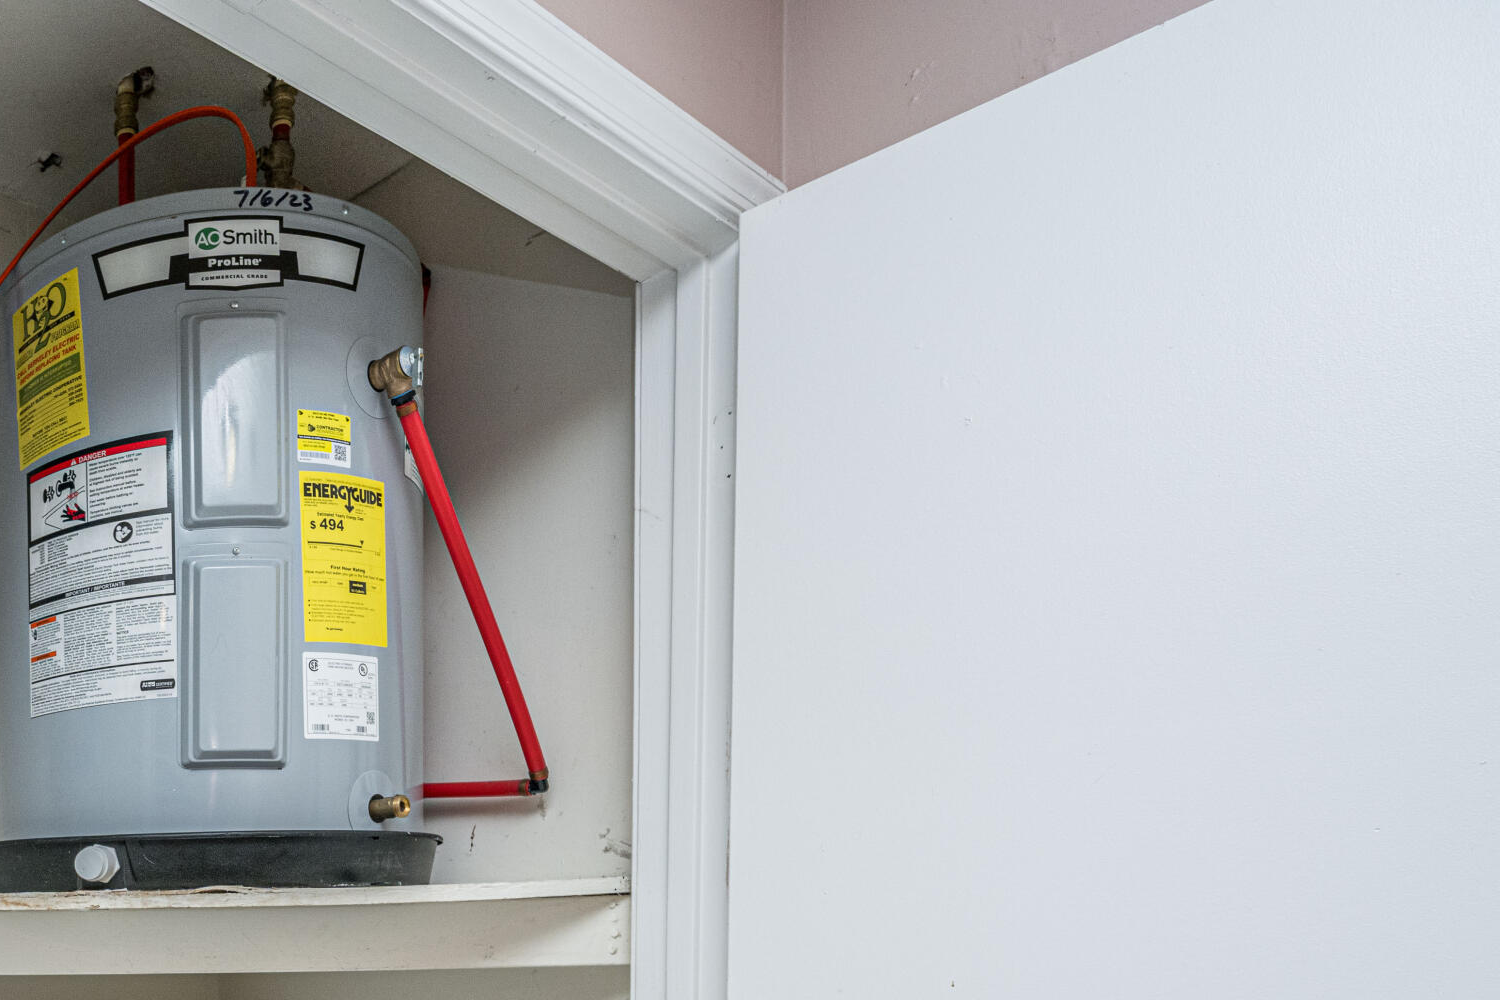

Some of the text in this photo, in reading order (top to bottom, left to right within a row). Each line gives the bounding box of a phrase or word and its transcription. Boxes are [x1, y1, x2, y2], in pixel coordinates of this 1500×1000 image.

[233, 189, 313, 211] 7/6/23
[195, 229, 220, 247] AO
[207, 257, 260, 268] ProLine
[201, 274, 244, 282] COMMERCIAL
[52, 333, 80, 352] ELECTRIC
[61, 344, 77, 355] TANK
[78, 449, 107, 463] DANGER
[303, 482, 382, 508] ENERGYGUIDE
[319, 518, 345, 531] 494
[65, 587, 91, 598] IMPORTANT
